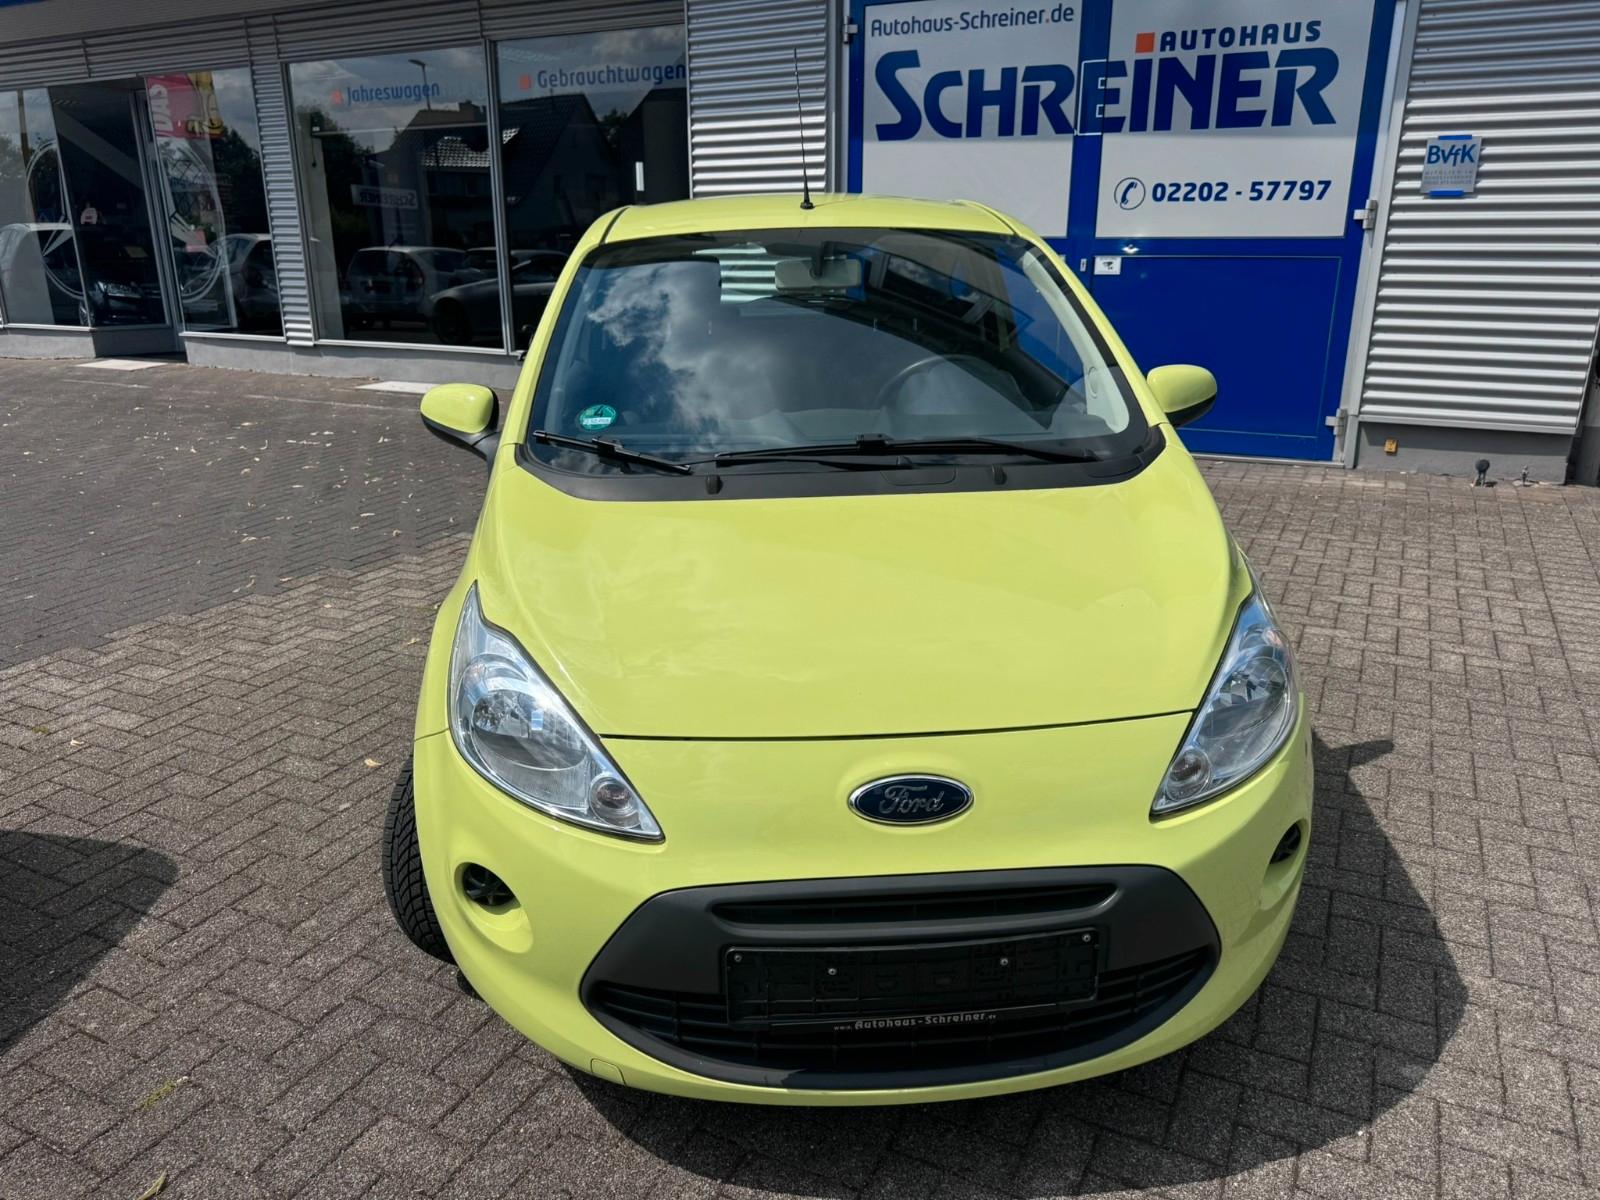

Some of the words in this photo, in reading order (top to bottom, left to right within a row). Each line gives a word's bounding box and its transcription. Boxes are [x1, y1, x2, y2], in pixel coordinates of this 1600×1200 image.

[871, 3, 1075, 37] Autohaus-Schreiner.de
[1159, 20, 1322, 53] AUTOHAUS
[537, 64, 686, 88] Gebrauchtwagen
[346, 82, 440, 107] Jahreswagen
[874, 47, 1340, 141] SCHREINER
[1427, 143, 1476, 167] BVfK
[1152, 181, 1229, 202] 02202
[1249, 180, 1332, 201] 57797
[880, 785, 945, 814] Ford
